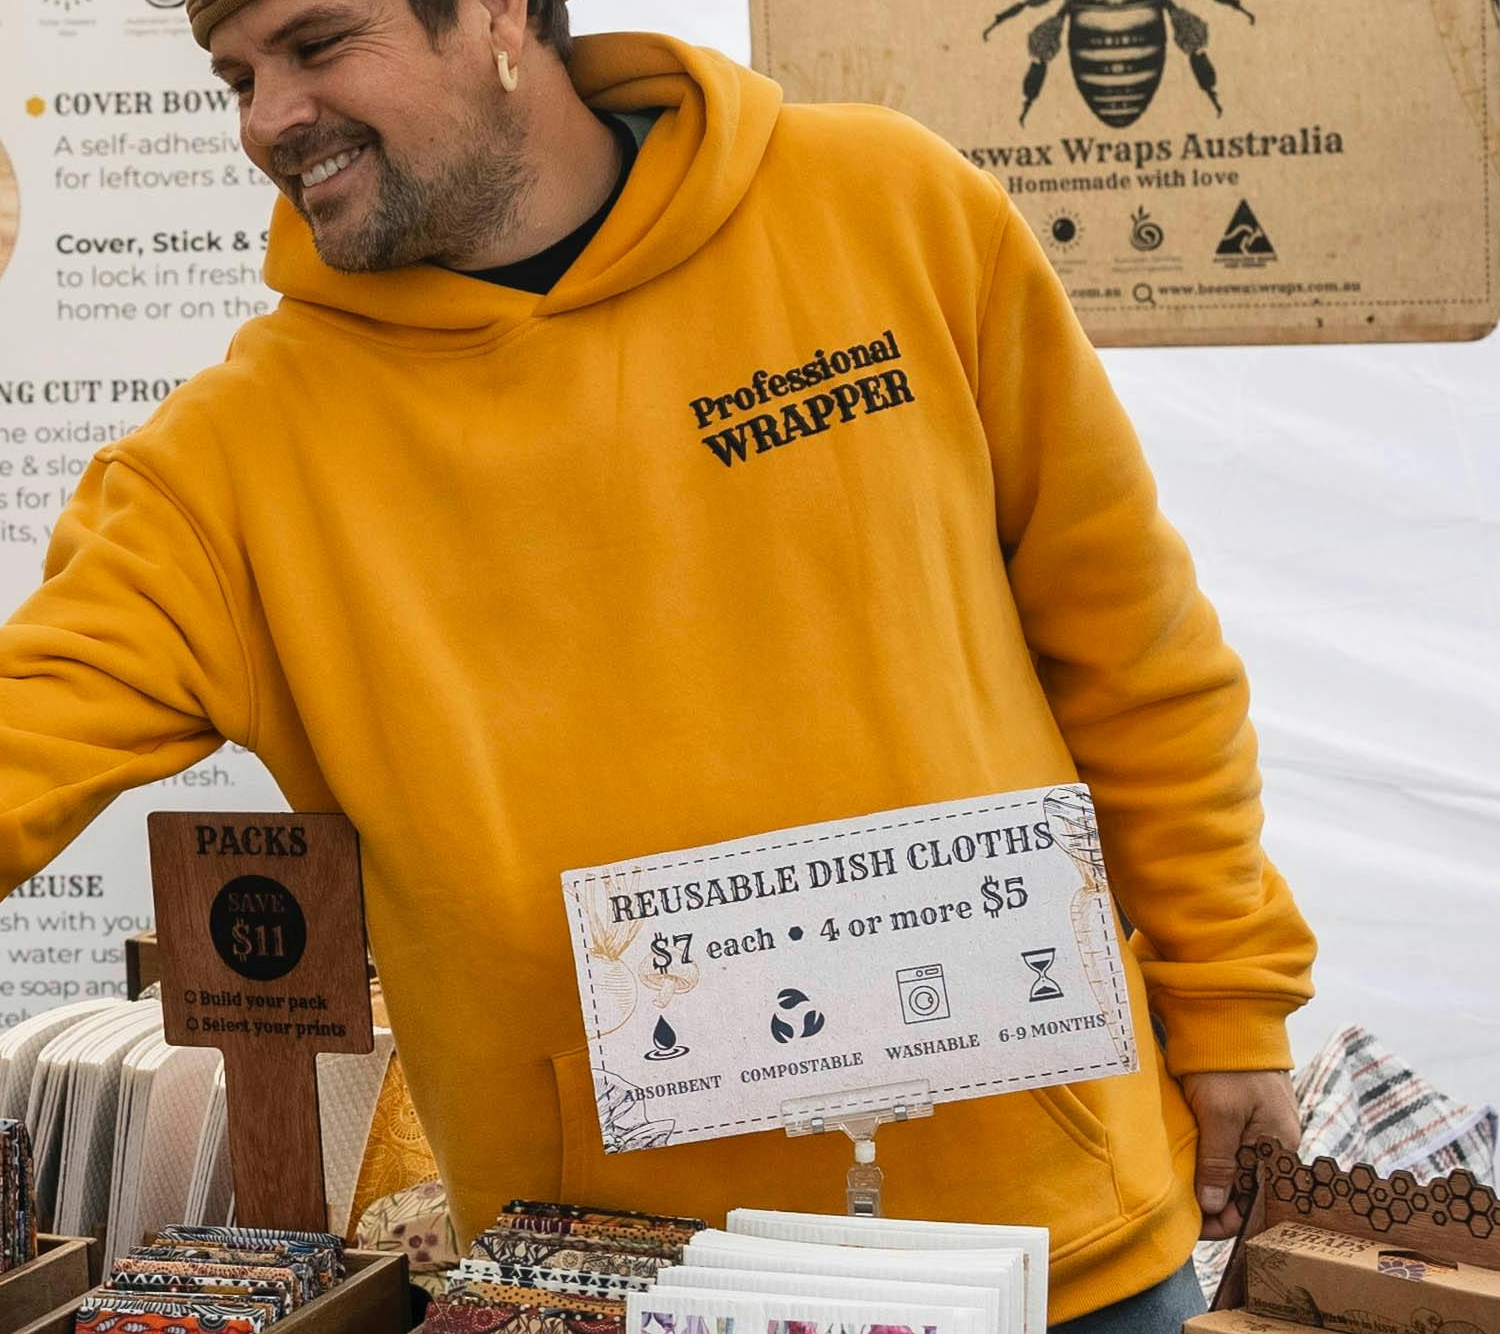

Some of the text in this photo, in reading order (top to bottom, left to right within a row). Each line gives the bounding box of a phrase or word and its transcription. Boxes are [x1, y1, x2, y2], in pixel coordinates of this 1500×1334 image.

[54, 91, 152, 116] COVER
[54, 130, 241, 156] A self-adhesiv
[1061, 126, 1344, 168] Wraps Australia
[55, 165, 239, 190] for leftovers &
[1008, 168, 1239, 195] Homemade with love
[56, 230, 250, 256] Cover, Stick &
[56, 265, 179, 288] to lock in
[57, 296, 269, 321] home or on the
[689, 330, 901, 429] Professional
[45, 380, 103, 405] CUT
[702, 369, 915, 468] WRAPPER
[23, 455, 40, 476] &
[16, 486, 52, 509] for
[195, 826, 308, 857] PACKS
[610, 820, 1056, 925] REUSABLE DISH CLOTHS
[228, 891, 285, 913] SAVE
[36, 911, 95, 931] with
[650, 877, 1030, 975] $7 each 4 or more $5
[232, 918, 287, 963] $11
[8, 946, 83, 964] water
[20, 979, 80, 1003] soap
[200, 992, 328, 1013] Build your pack
[202, 1017, 346, 1040] Select your prints
[998, 1012, 1108, 1045] 6-9 MONTHS
[885, 1033, 981, 1062] WASHABLE
[740, 1051, 865, 1084] COMPOSTABLE
[624, 1073, 723, 1104] ABSORBENT
[1280, 1229, 1371, 1253] WRAPS
